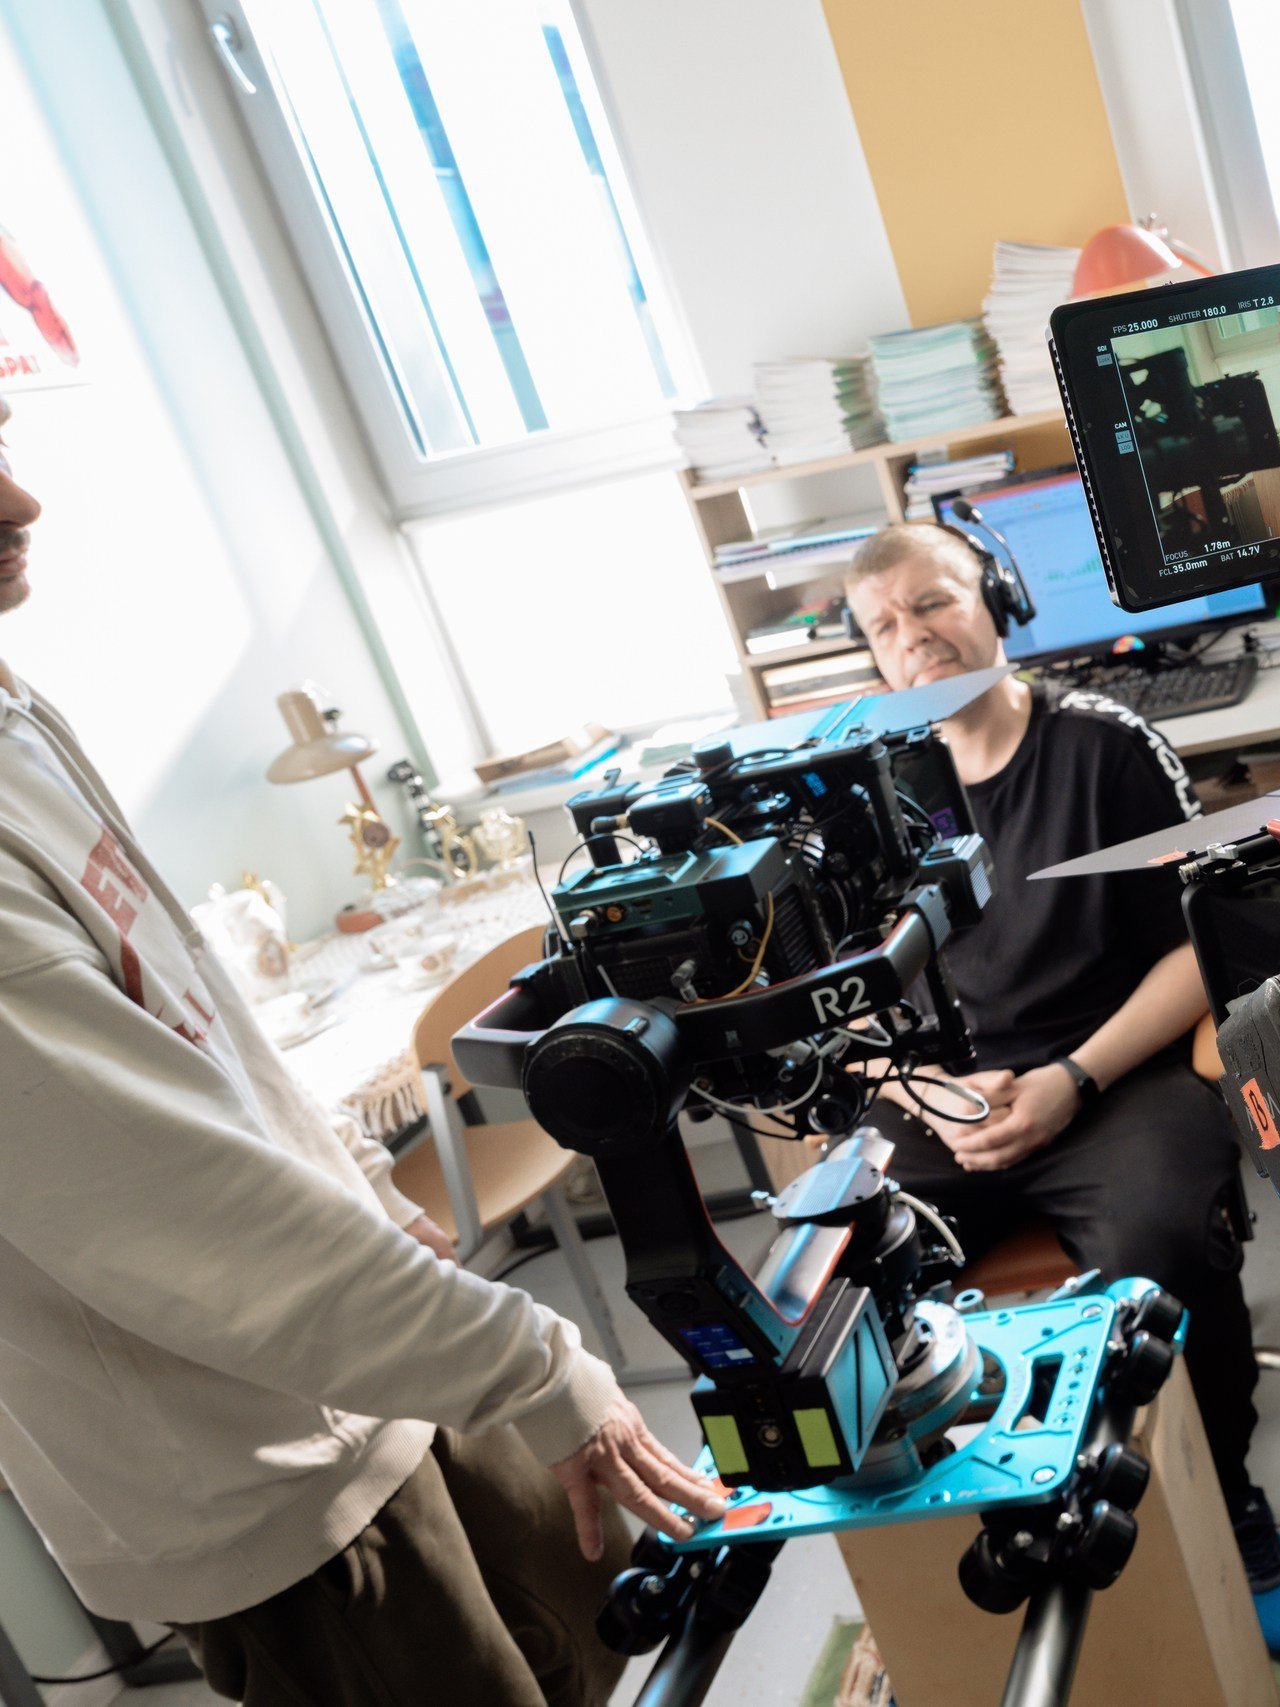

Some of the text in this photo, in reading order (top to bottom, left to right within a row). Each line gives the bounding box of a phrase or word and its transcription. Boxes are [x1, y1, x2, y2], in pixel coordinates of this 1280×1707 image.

[1238, 296, 1274, 309] IRIS T 2.8
[1168, 305, 1227, 323] SHUTTER 180.0
[1113, 319, 1158, 334] FPS 25.000
[1114, 421, 1127, 430] CAM
[1165, 540, 1231, 562] FOCUS 1.78m
[1159, 545, 1260, 577] FCL 35.0mm BAT 14.7V
[810, 976, 872, 1024] R2
